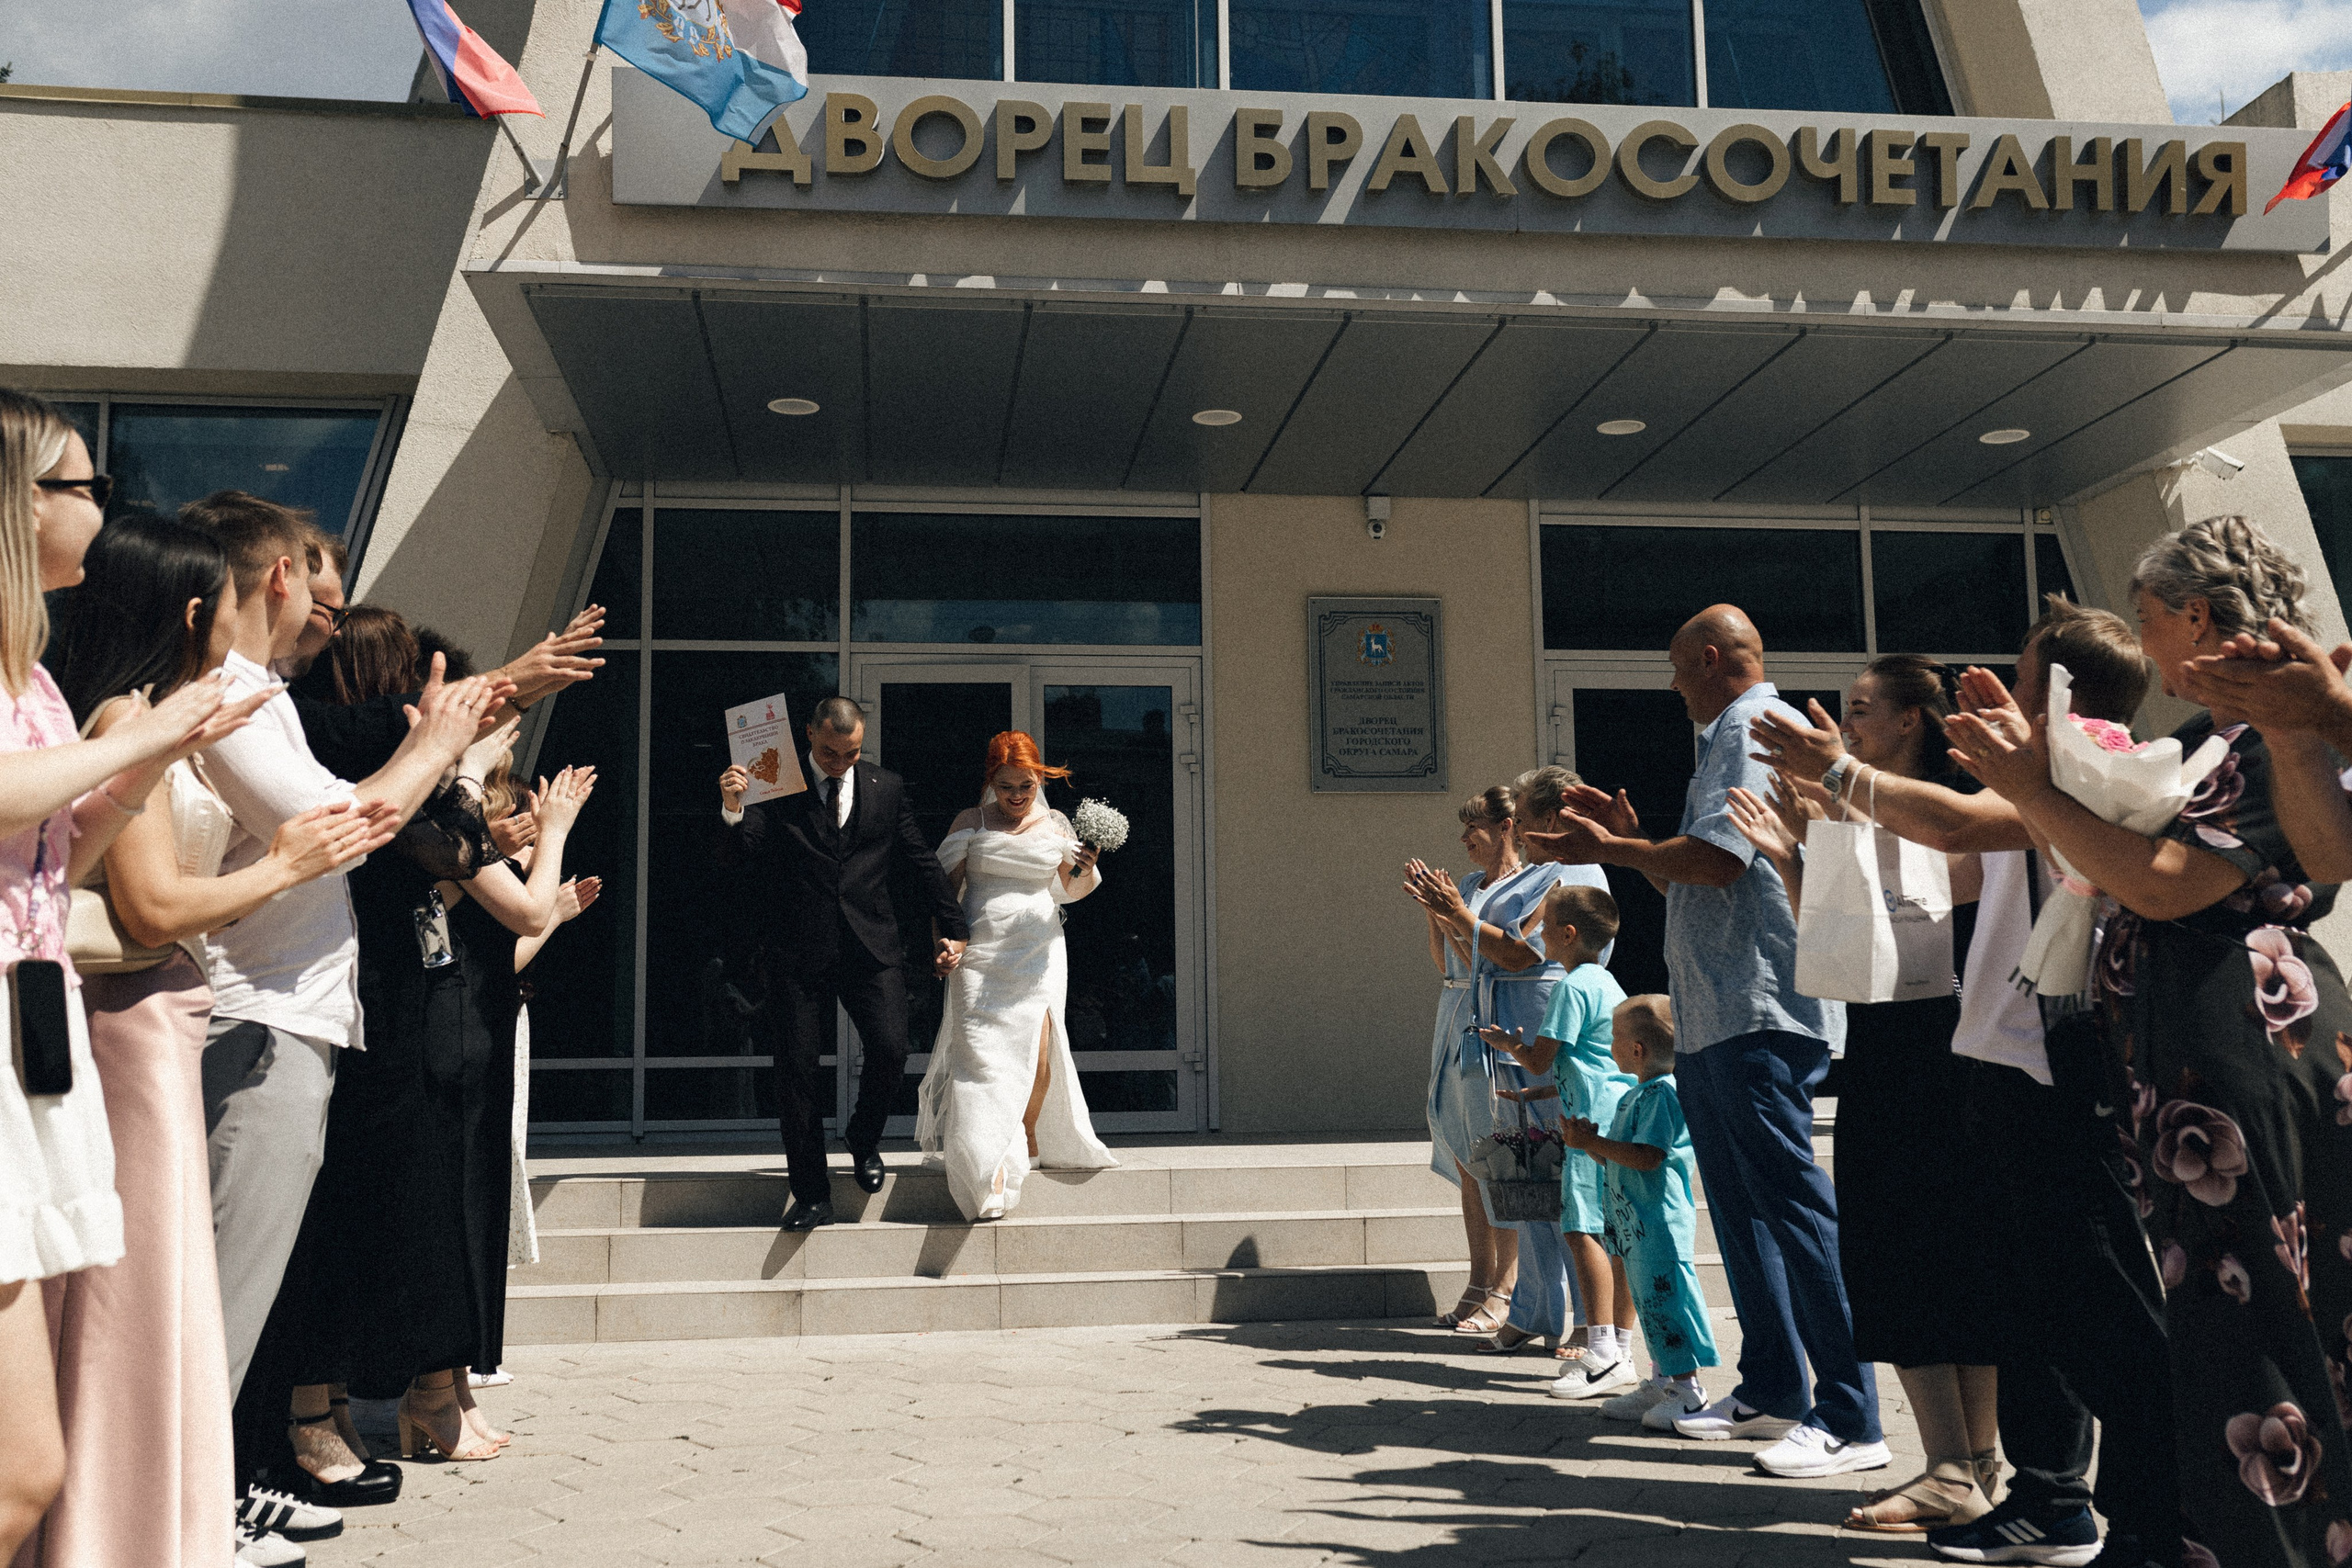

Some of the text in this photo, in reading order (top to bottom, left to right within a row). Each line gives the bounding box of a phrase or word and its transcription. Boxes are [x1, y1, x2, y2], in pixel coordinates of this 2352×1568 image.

[721, 92, 2247, 216] ДВОРЕЦ БРАКОСОЧЕТАНИЯ
[1358, 716, 1397, 726] ДВОРЕЦ
[1332, 727, 1424, 736] БРАКОСОЧЕТАНИЯ
[1346, 737, 1411, 747] ГОРОДСКОГО
[1339, 748, 1419, 756] ОКРУГА САМАРА
